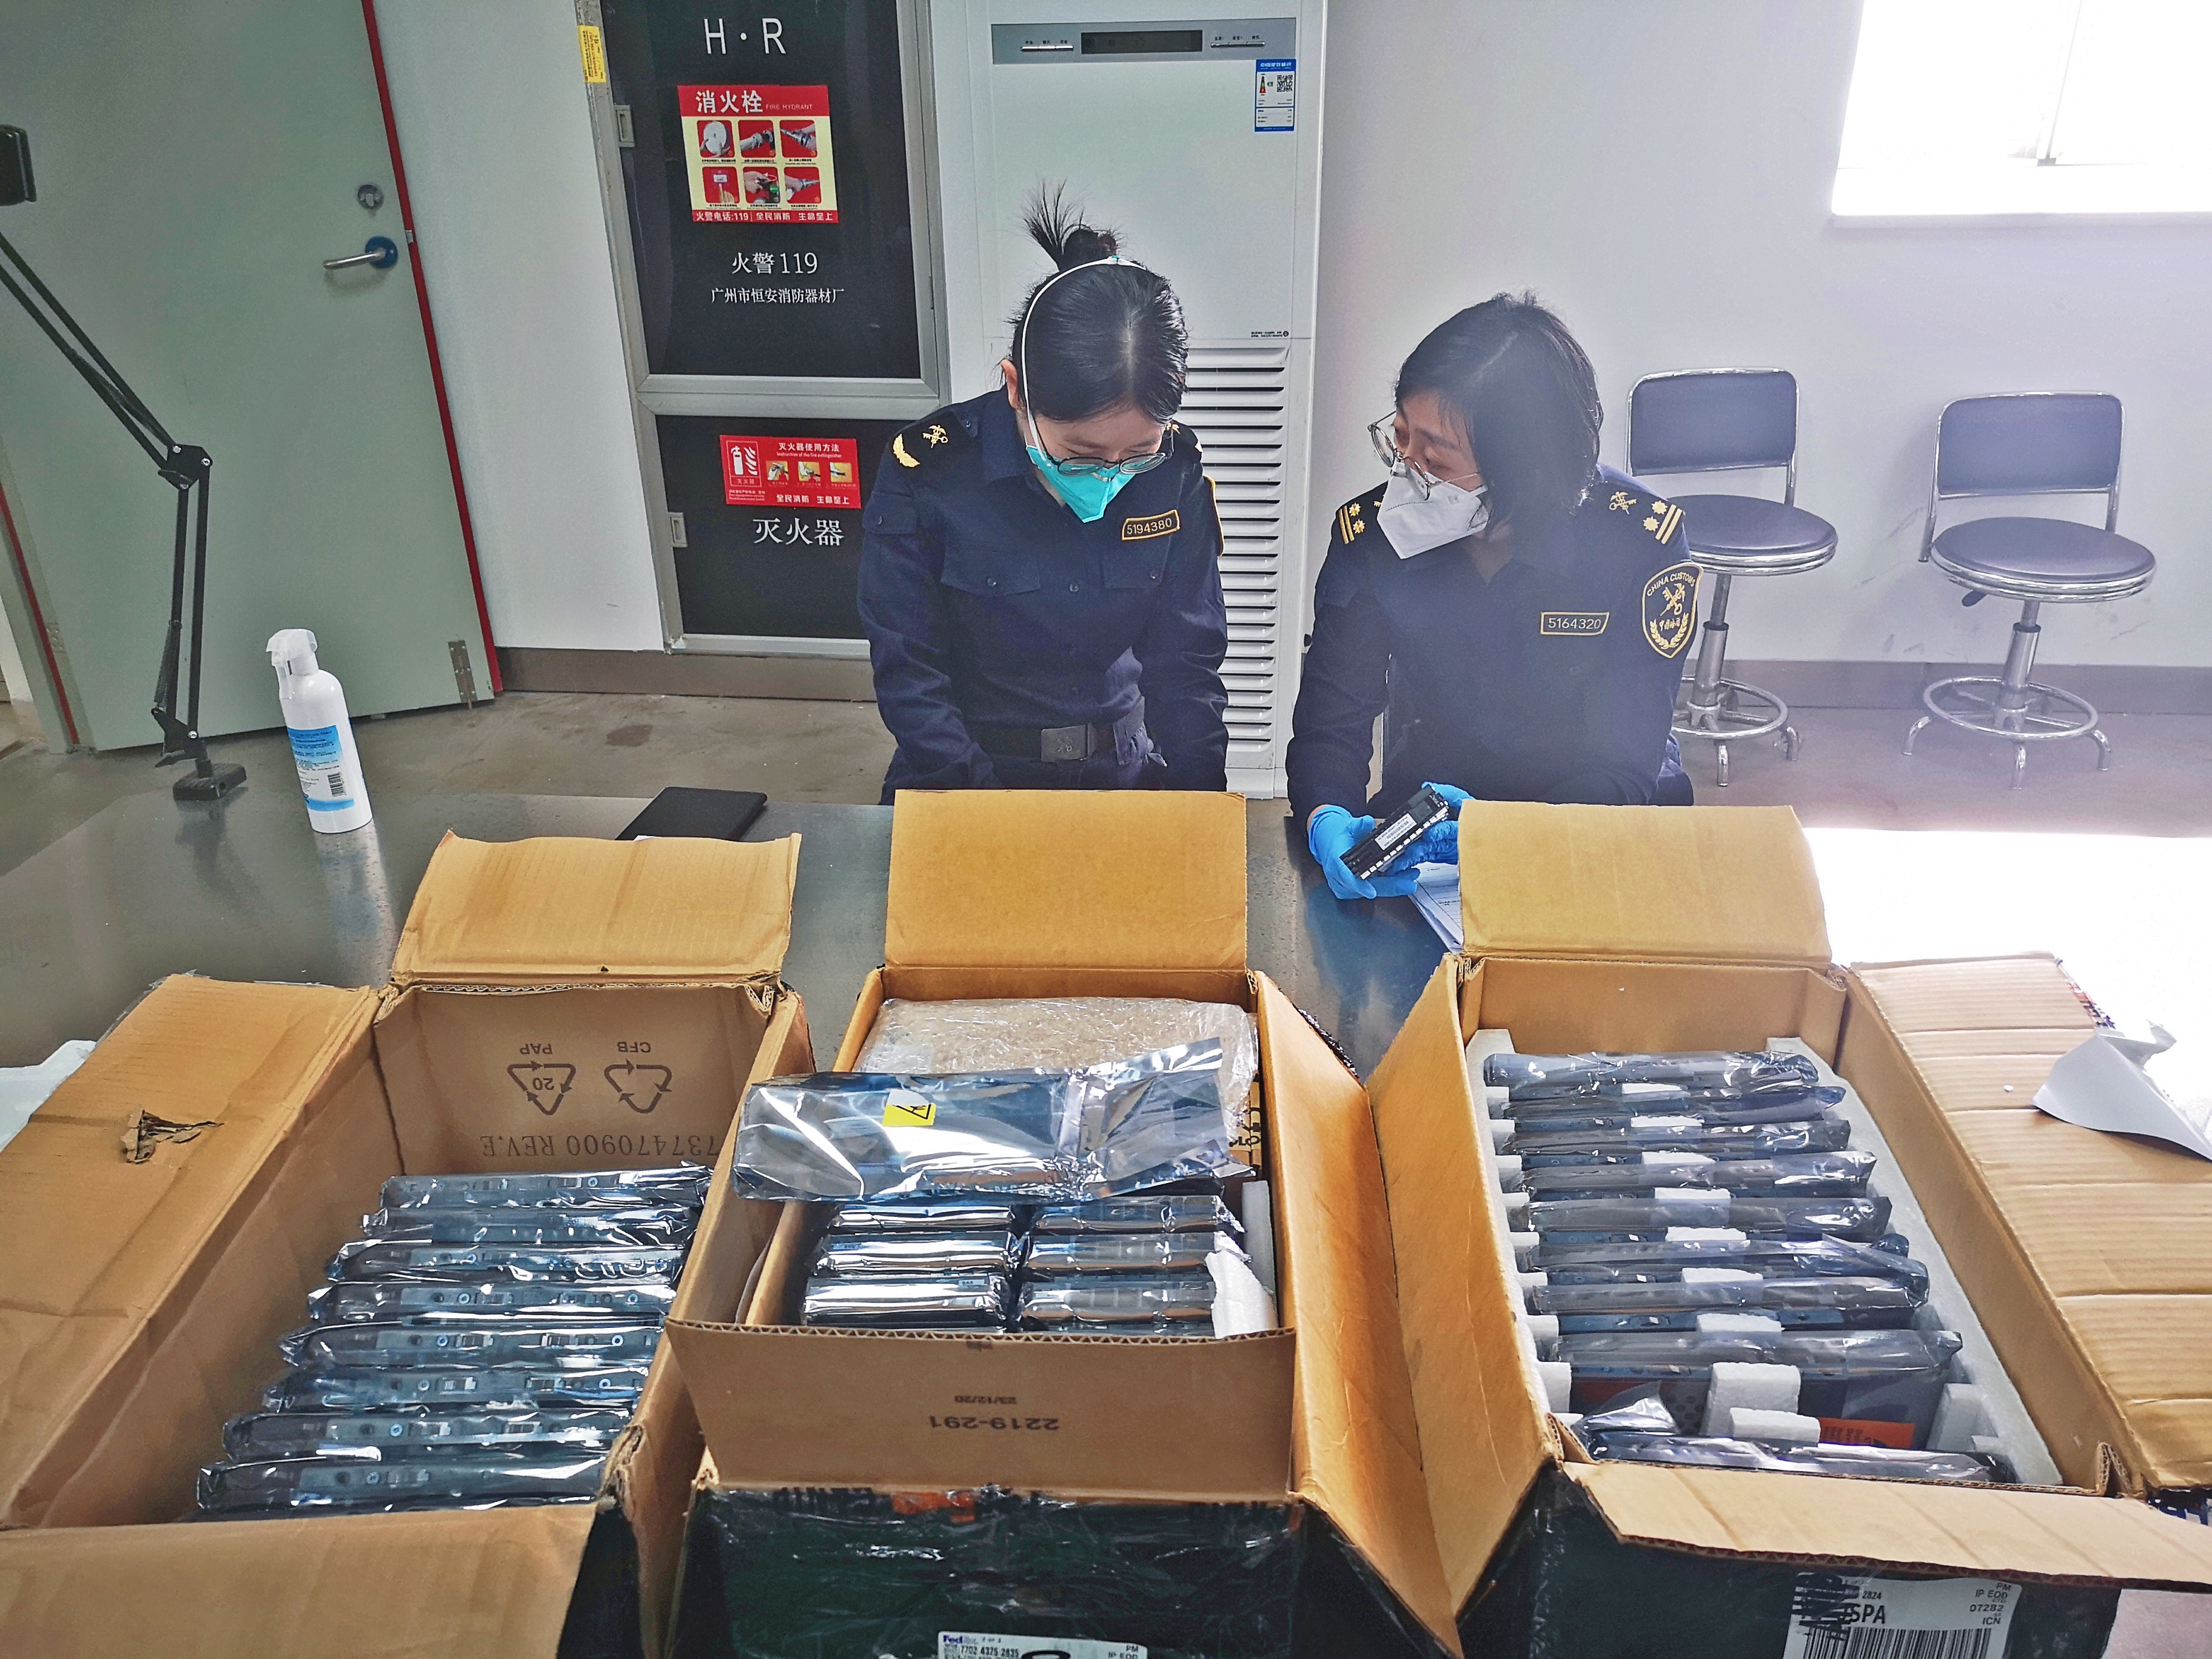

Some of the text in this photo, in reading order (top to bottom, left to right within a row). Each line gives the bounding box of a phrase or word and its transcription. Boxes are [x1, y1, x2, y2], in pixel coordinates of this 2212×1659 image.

[695, 90, 763, 113] 消火栓
[711, 287, 844, 303] 广州市恒安消防器材厂
[779, 443, 840, 452] 灭火器使用方法
[752, 517, 844, 546] 灭火器
[1127, 518, 1172, 534] 5194380
[1647, 572, 1695, 597] CHINA CUSTOMS
[1548, 618, 1601, 629] 5164320
[520, 1044, 552, 1054] PAP
[617, 1041, 651, 1053] CFB
[532, 1078, 554, 1090] 20
[480, 1134, 720, 1156] 737470900 REV.E
[930, 1415, 1059, 1430] 2219-291
[1976, 1589, 1984, 1597] IP
